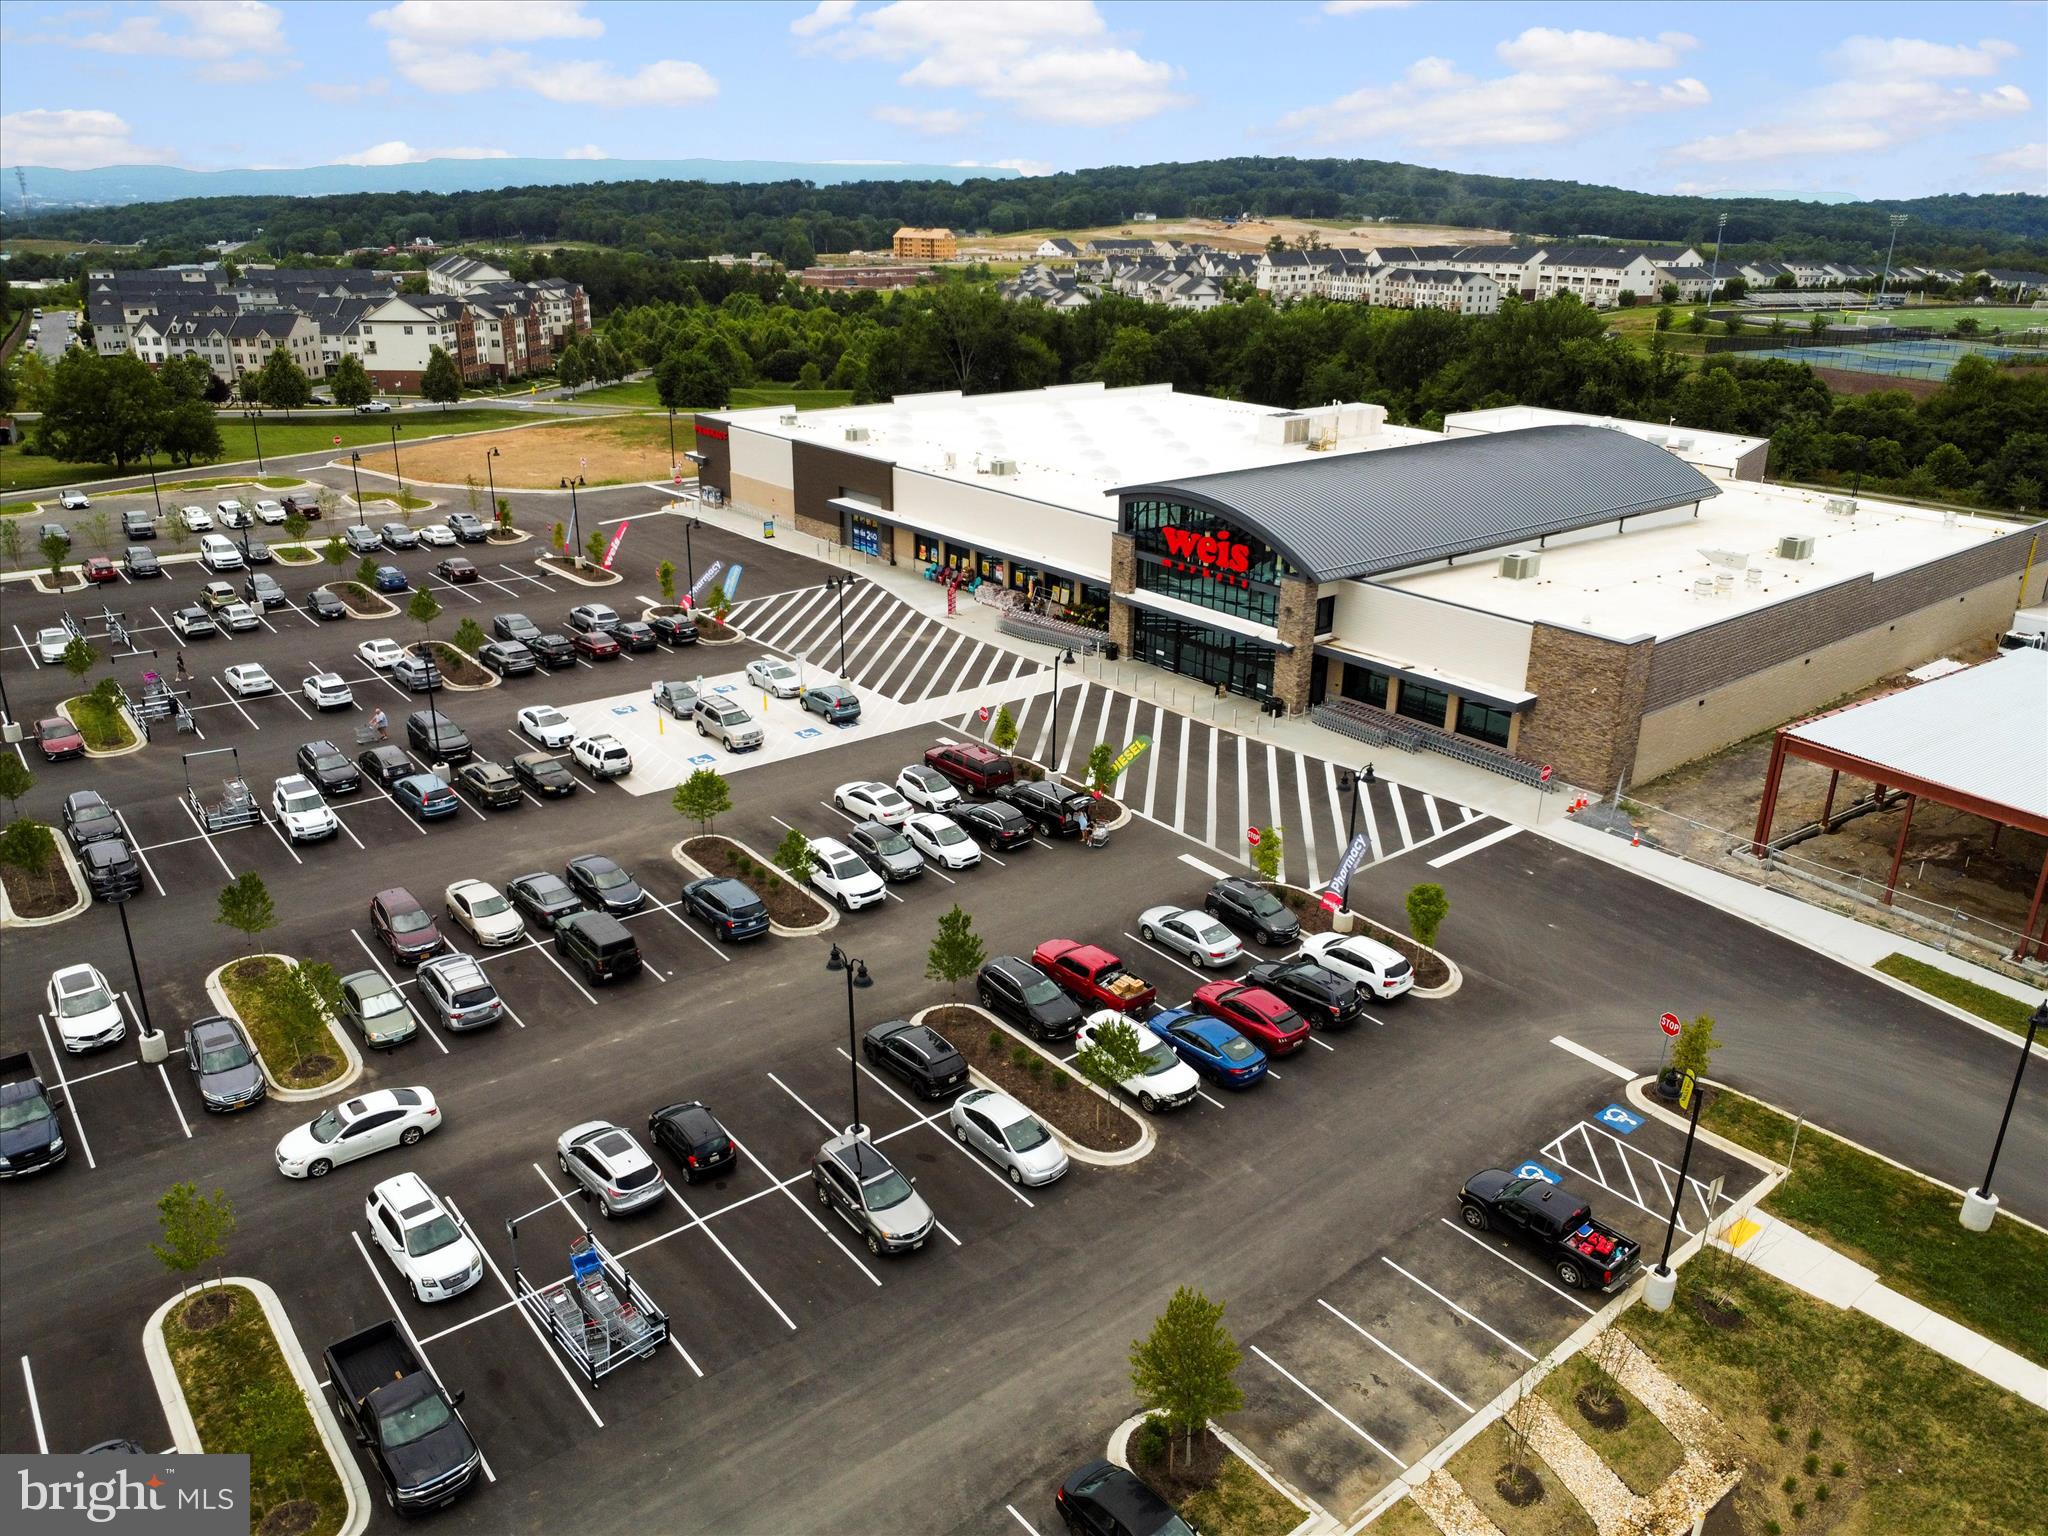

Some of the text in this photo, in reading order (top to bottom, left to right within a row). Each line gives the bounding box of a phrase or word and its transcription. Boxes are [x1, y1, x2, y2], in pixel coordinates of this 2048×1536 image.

[1247, 830, 1260, 841] STOP
[1331, 833, 1367, 893] Pharmacy
[1661, 1016, 1680, 1032] STOP
